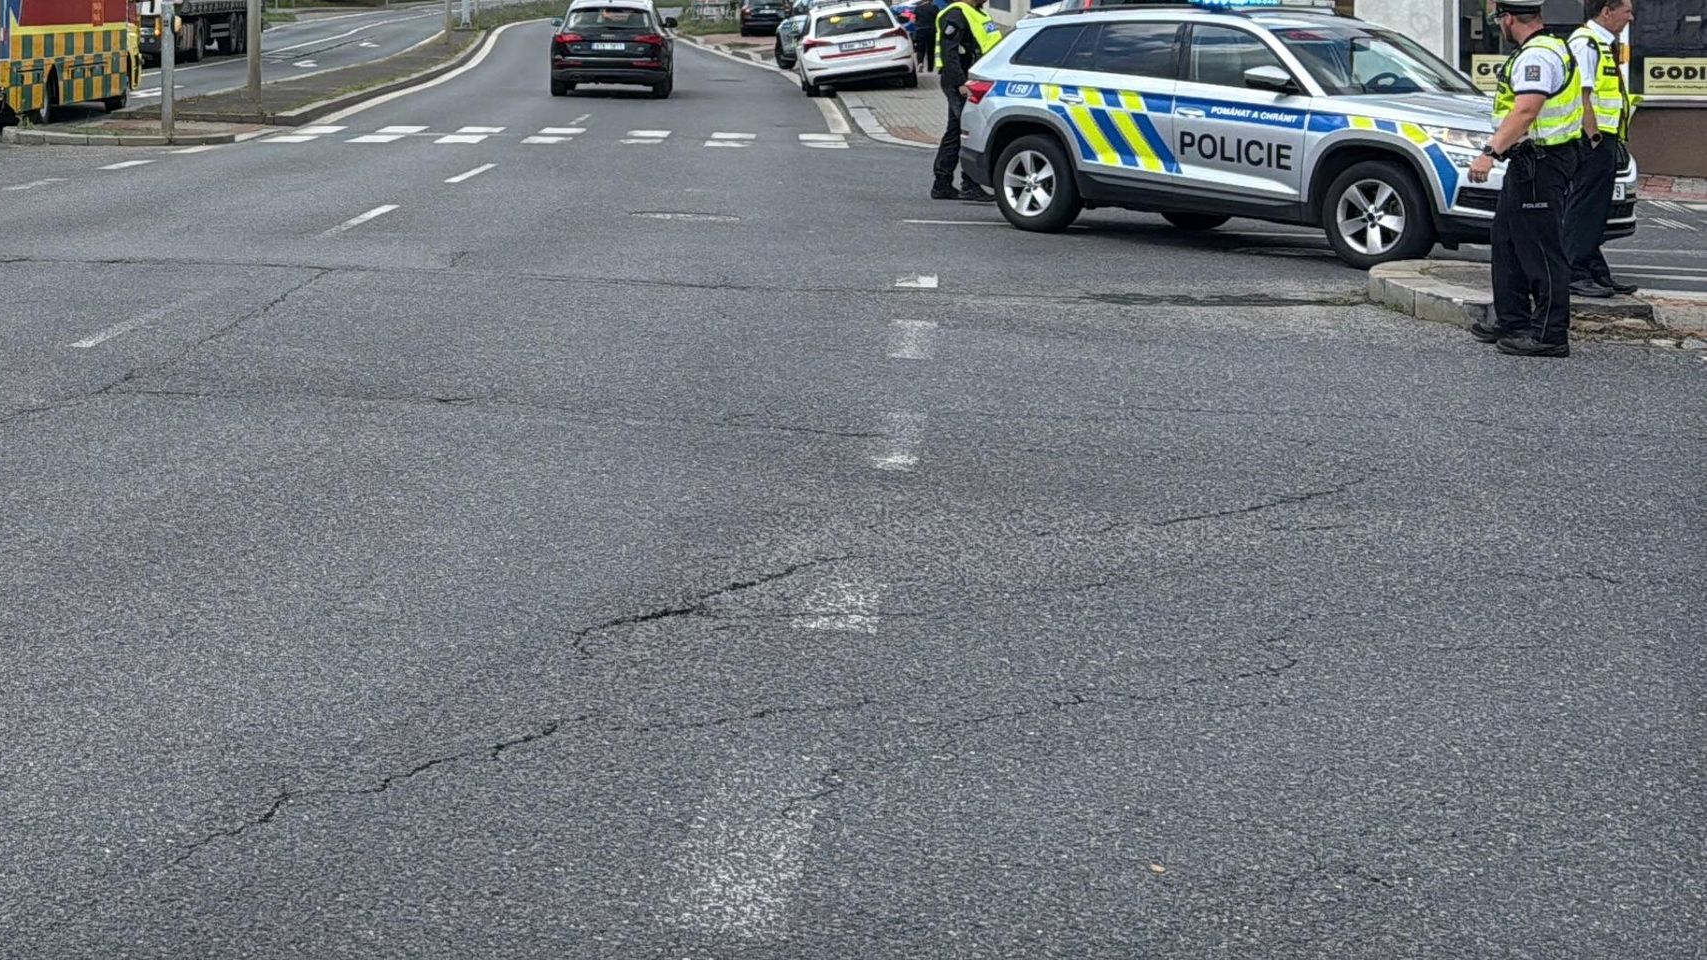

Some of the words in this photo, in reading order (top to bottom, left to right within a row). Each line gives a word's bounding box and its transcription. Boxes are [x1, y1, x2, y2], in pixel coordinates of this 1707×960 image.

[1649, 66, 1706, 80] GODI
[1010, 83, 1030, 94] 158
[1210, 106, 1252, 118] POMÁHAT
[1251, 111, 1259, 119] A
[1260, 111, 1298, 123] CHRÁNIT
[1179, 130, 1292, 171] POLICIE
